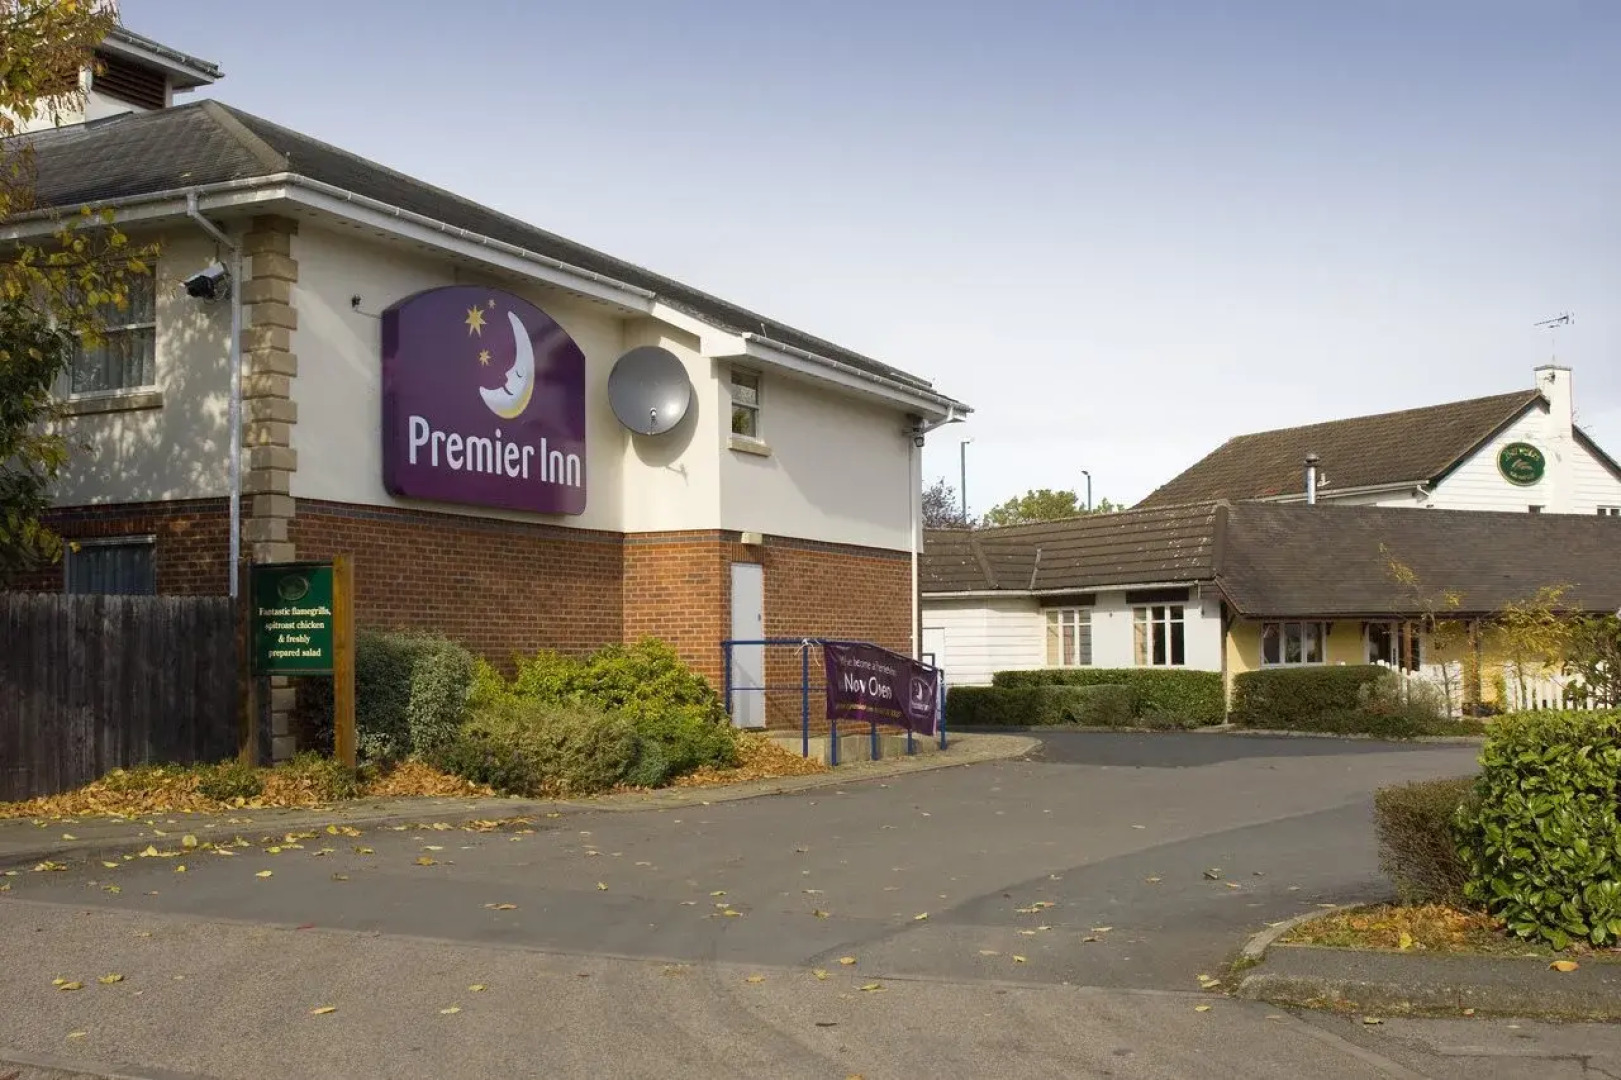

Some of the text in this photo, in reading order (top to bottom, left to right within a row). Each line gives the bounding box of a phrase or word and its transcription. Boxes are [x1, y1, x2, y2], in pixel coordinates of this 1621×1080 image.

[408, 415, 581, 487] Premier Inn
[259, 607, 290, 616] Fantastic
[296, 620, 325, 628] chicken
[278, 634, 310, 644] & freshly
[268, 648, 321, 658] prepared salad
